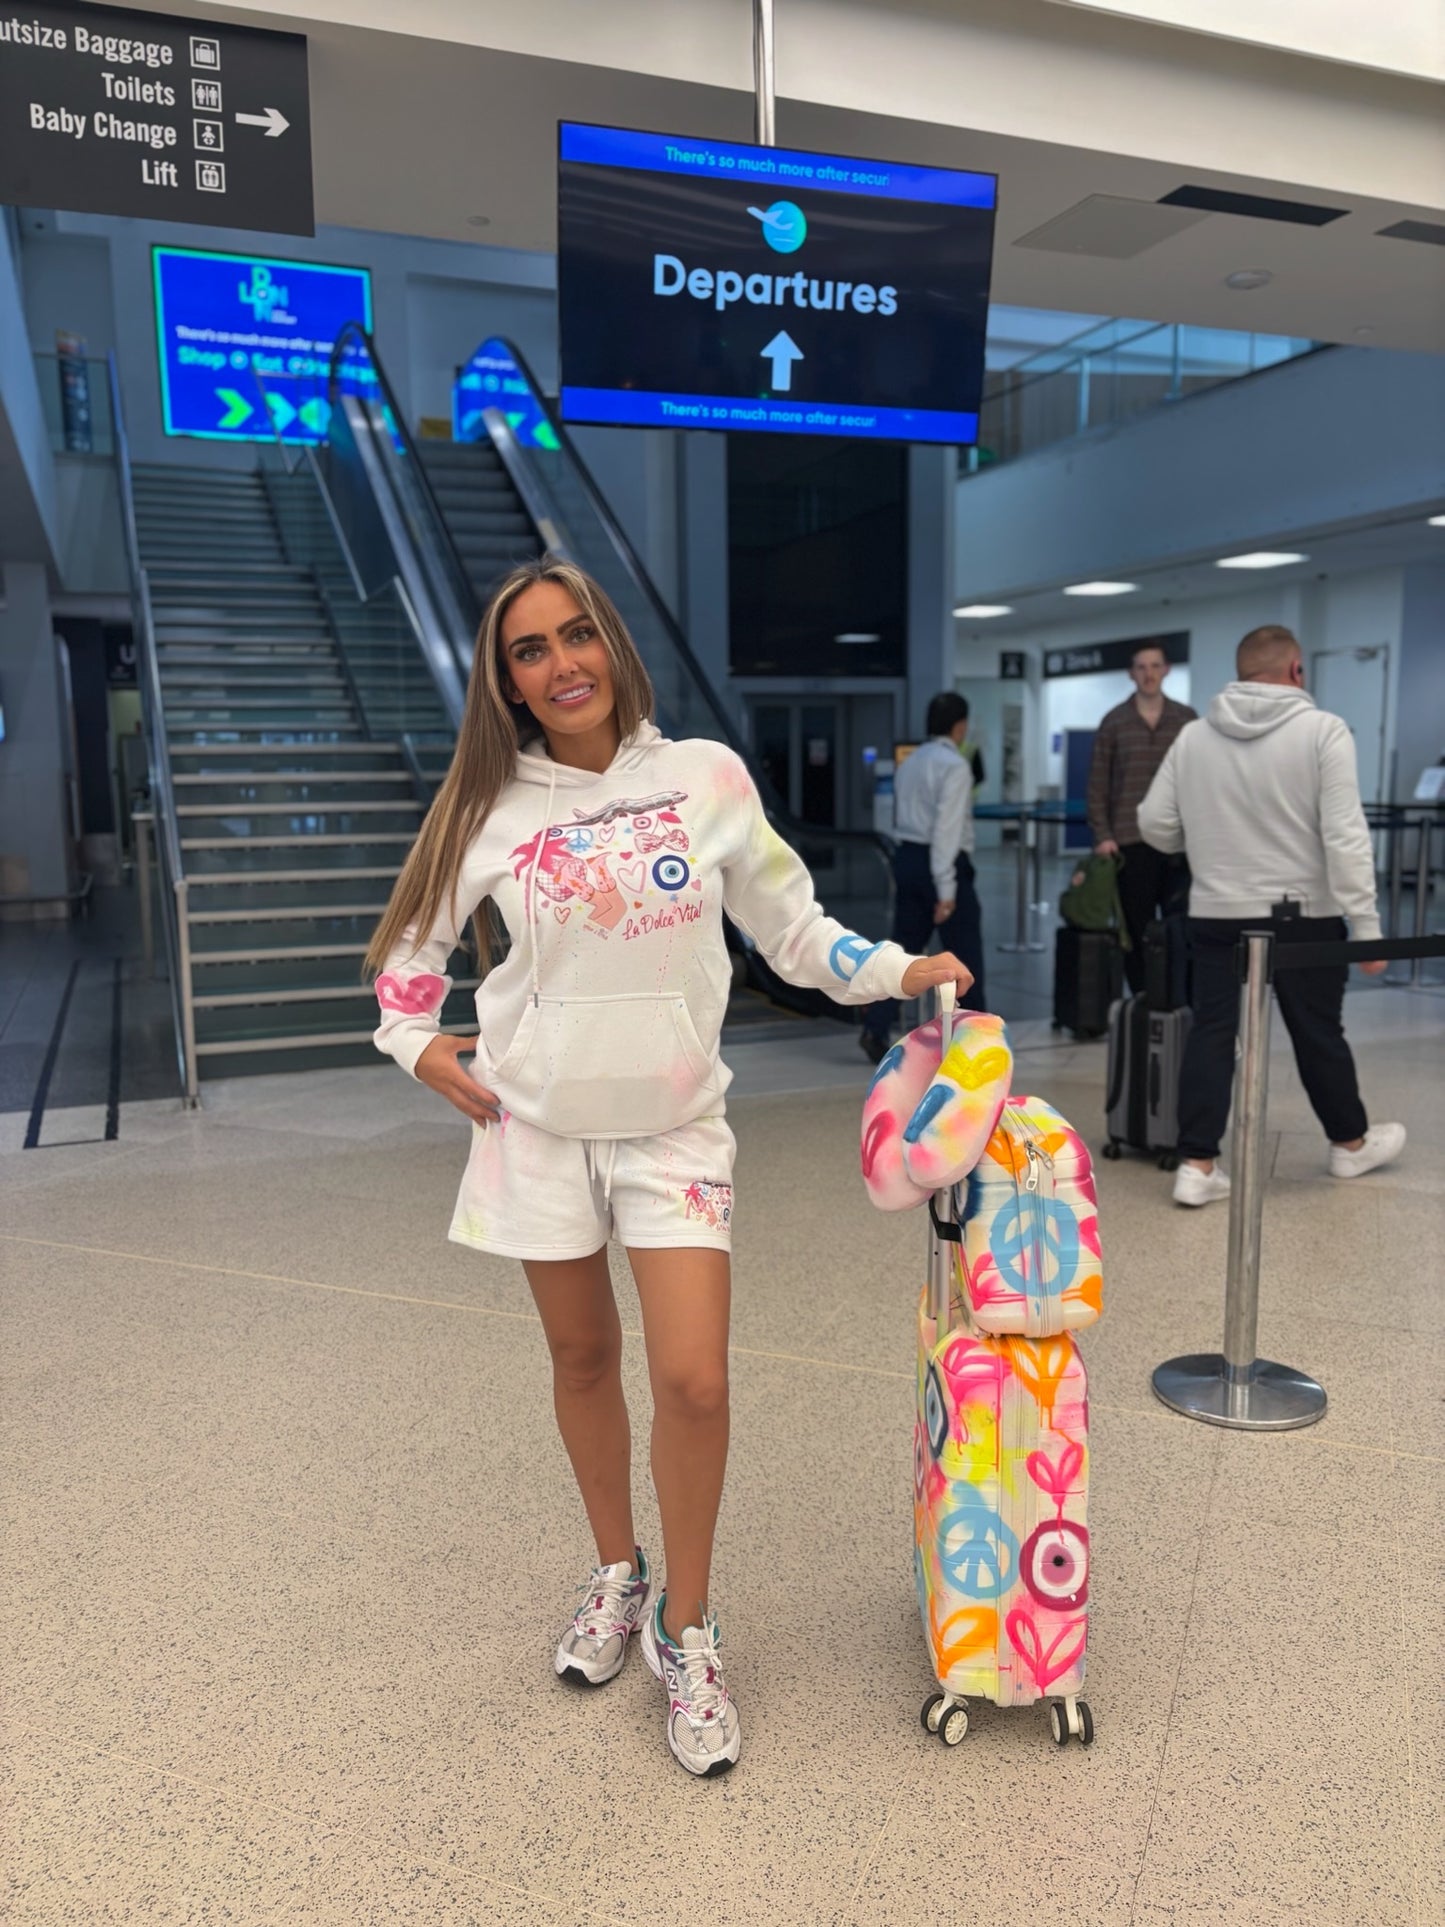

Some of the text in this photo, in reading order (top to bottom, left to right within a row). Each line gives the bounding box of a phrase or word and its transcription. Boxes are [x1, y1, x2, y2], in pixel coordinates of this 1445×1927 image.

[74, 26, 173, 68] Baggage
[101, 72, 176, 106] Toilets
[30, 103, 177, 149] Baby Change
[141, 159, 178, 188] Lift
[665, 146, 715, 166] There's
[719, 155, 735, 168] so
[738, 158, 776, 173] much
[778, 162, 813, 178] more
[816, 166, 850, 182] after
[653, 254, 898, 316] Departures
[178, 345, 227, 371] Shop
[661, 401, 709, 417] There's
[712, 406, 728, 418] so
[730, 408, 766, 422] much
[769, 410, 804, 423] more
[806, 412, 838, 426] after
[622, 918, 640, 941] La
[640, 908, 675, 934] Dolce
